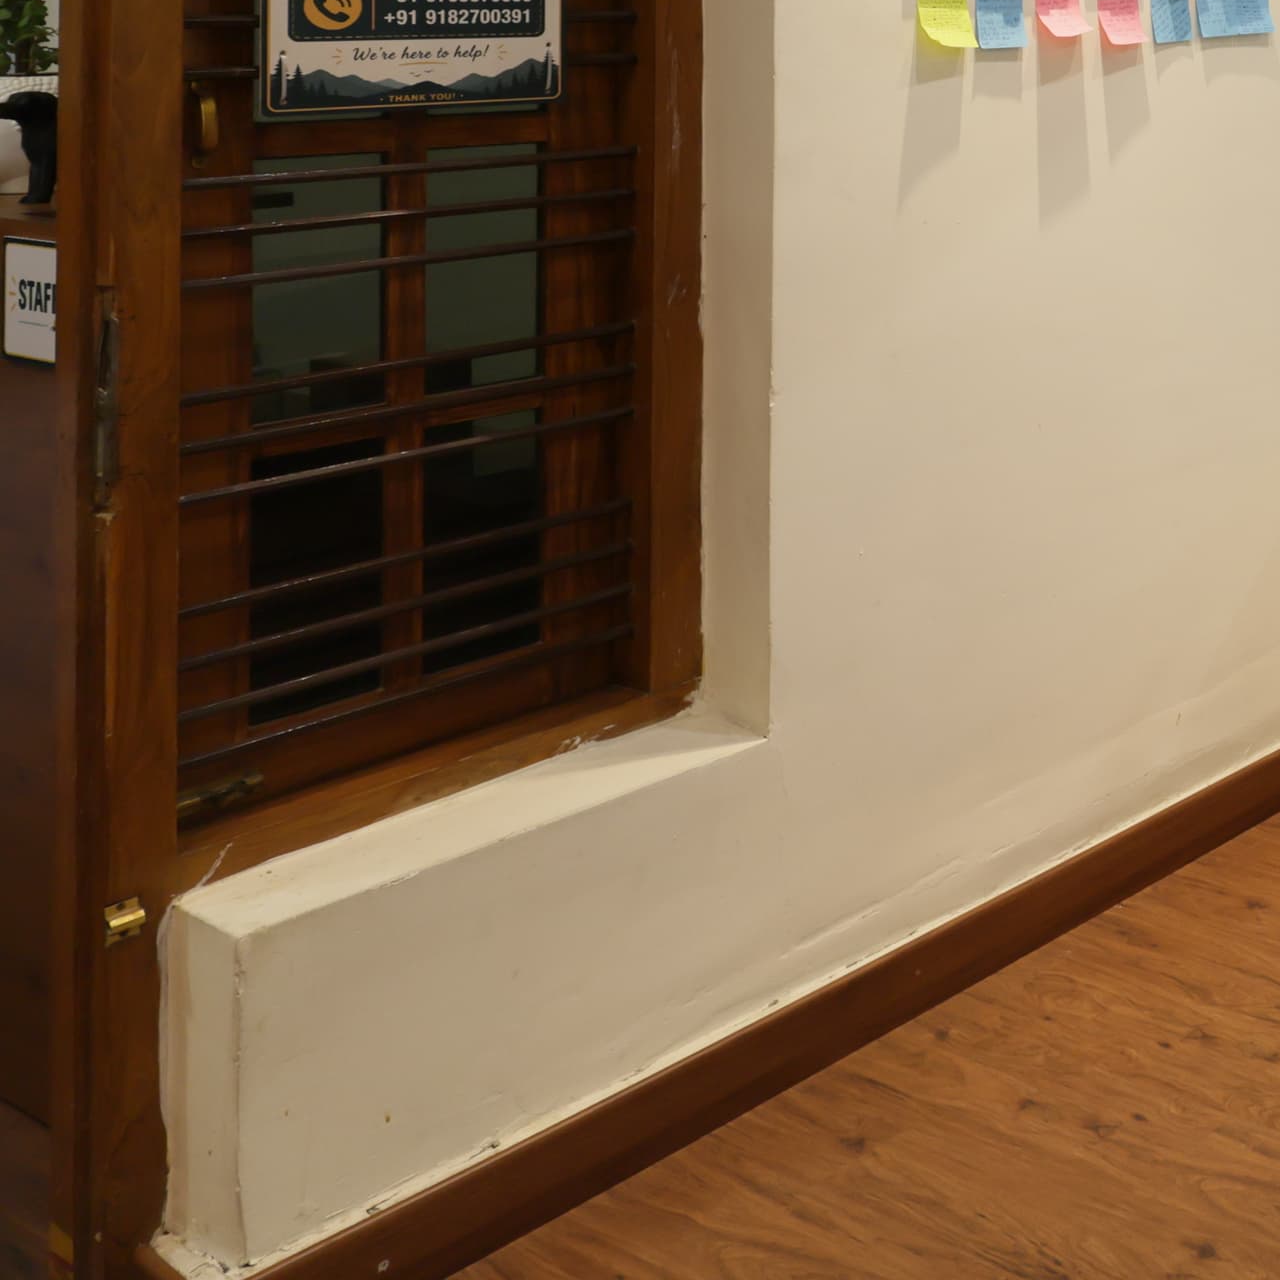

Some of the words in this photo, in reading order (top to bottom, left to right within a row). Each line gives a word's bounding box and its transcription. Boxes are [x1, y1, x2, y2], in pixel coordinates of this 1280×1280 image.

[383, 9, 417, 25] +91
[425, 8, 531, 25] 9182700391
[352, 46, 396, 62] We're
[400, 46, 432, 60] here
[436, 47, 449, 59] to
[453, 44, 490, 63] help!
[388, 94, 426, 103] THANK
[430, 93, 456, 102] YOU!
